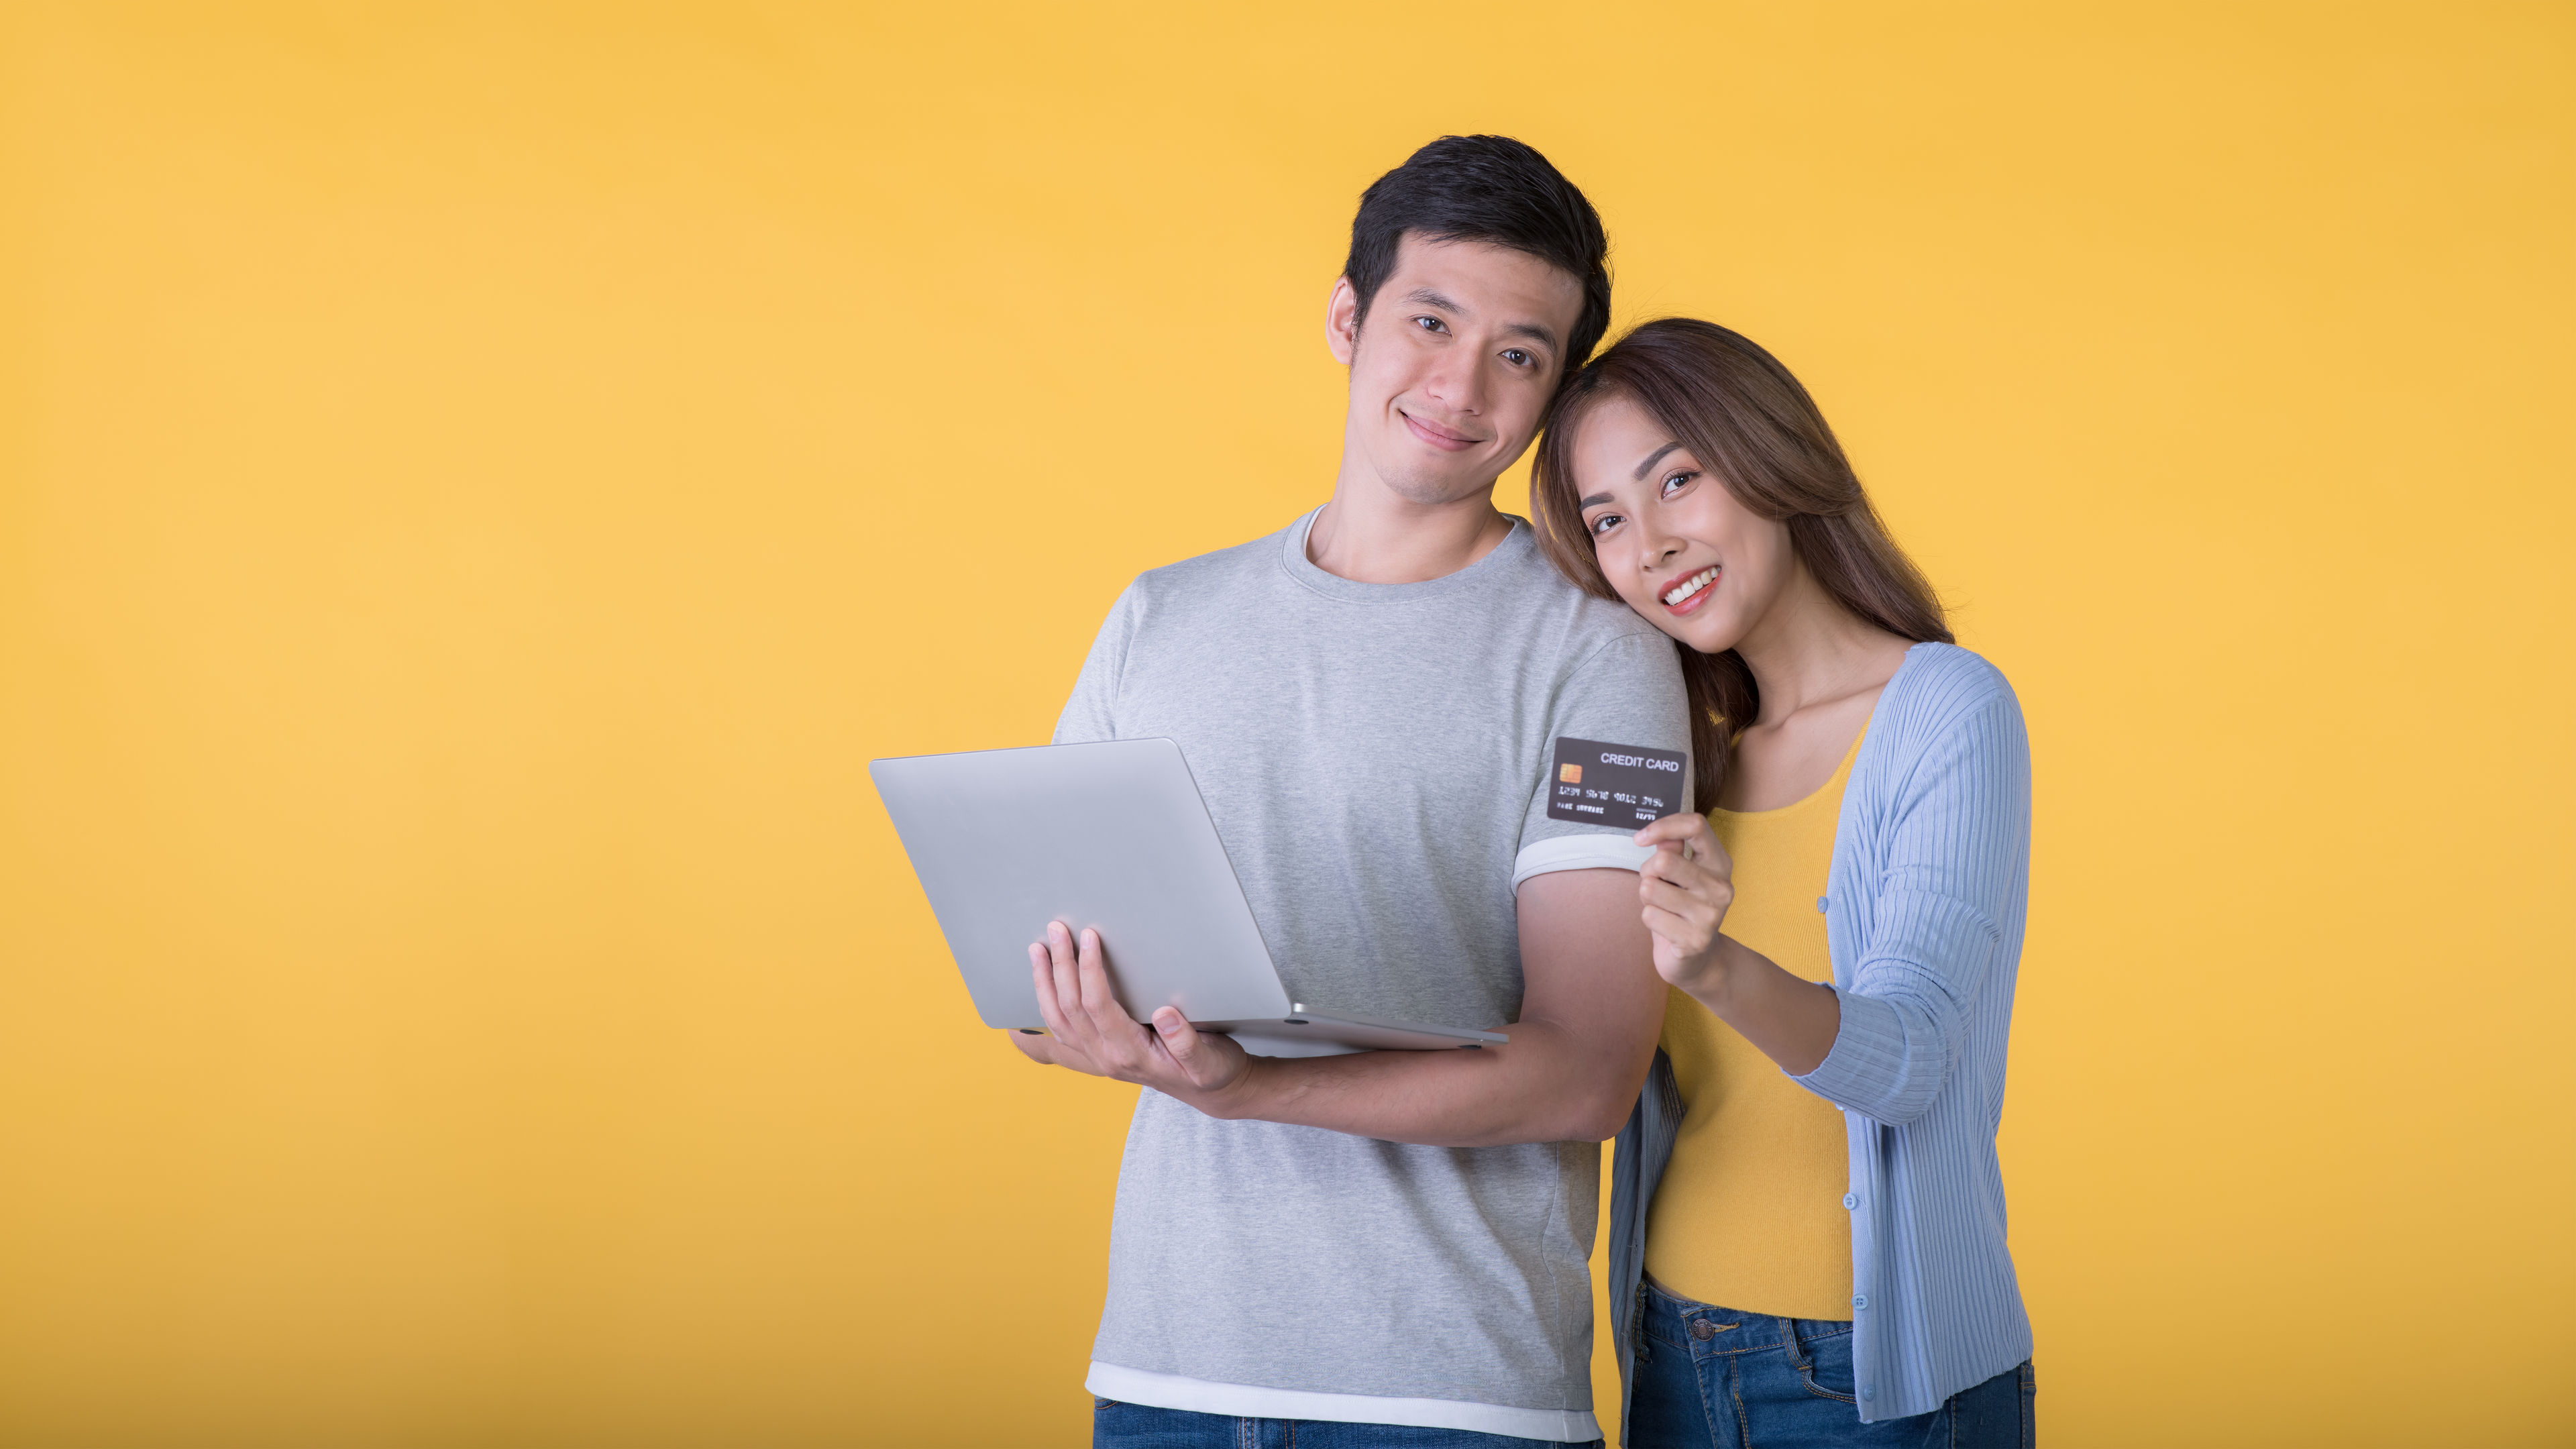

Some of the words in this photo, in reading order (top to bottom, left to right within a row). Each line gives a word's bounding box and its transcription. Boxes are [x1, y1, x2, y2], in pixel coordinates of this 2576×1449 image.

[1601, 753, 1644, 767] CREDIT
[1646, 759, 1678, 771] CARD
[1558, 786, 1580, 796] 1234
[1586, 790, 1609, 800] 5678
[1613, 793, 1636, 804] 9012
[1642, 796, 1664, 807] 3456
